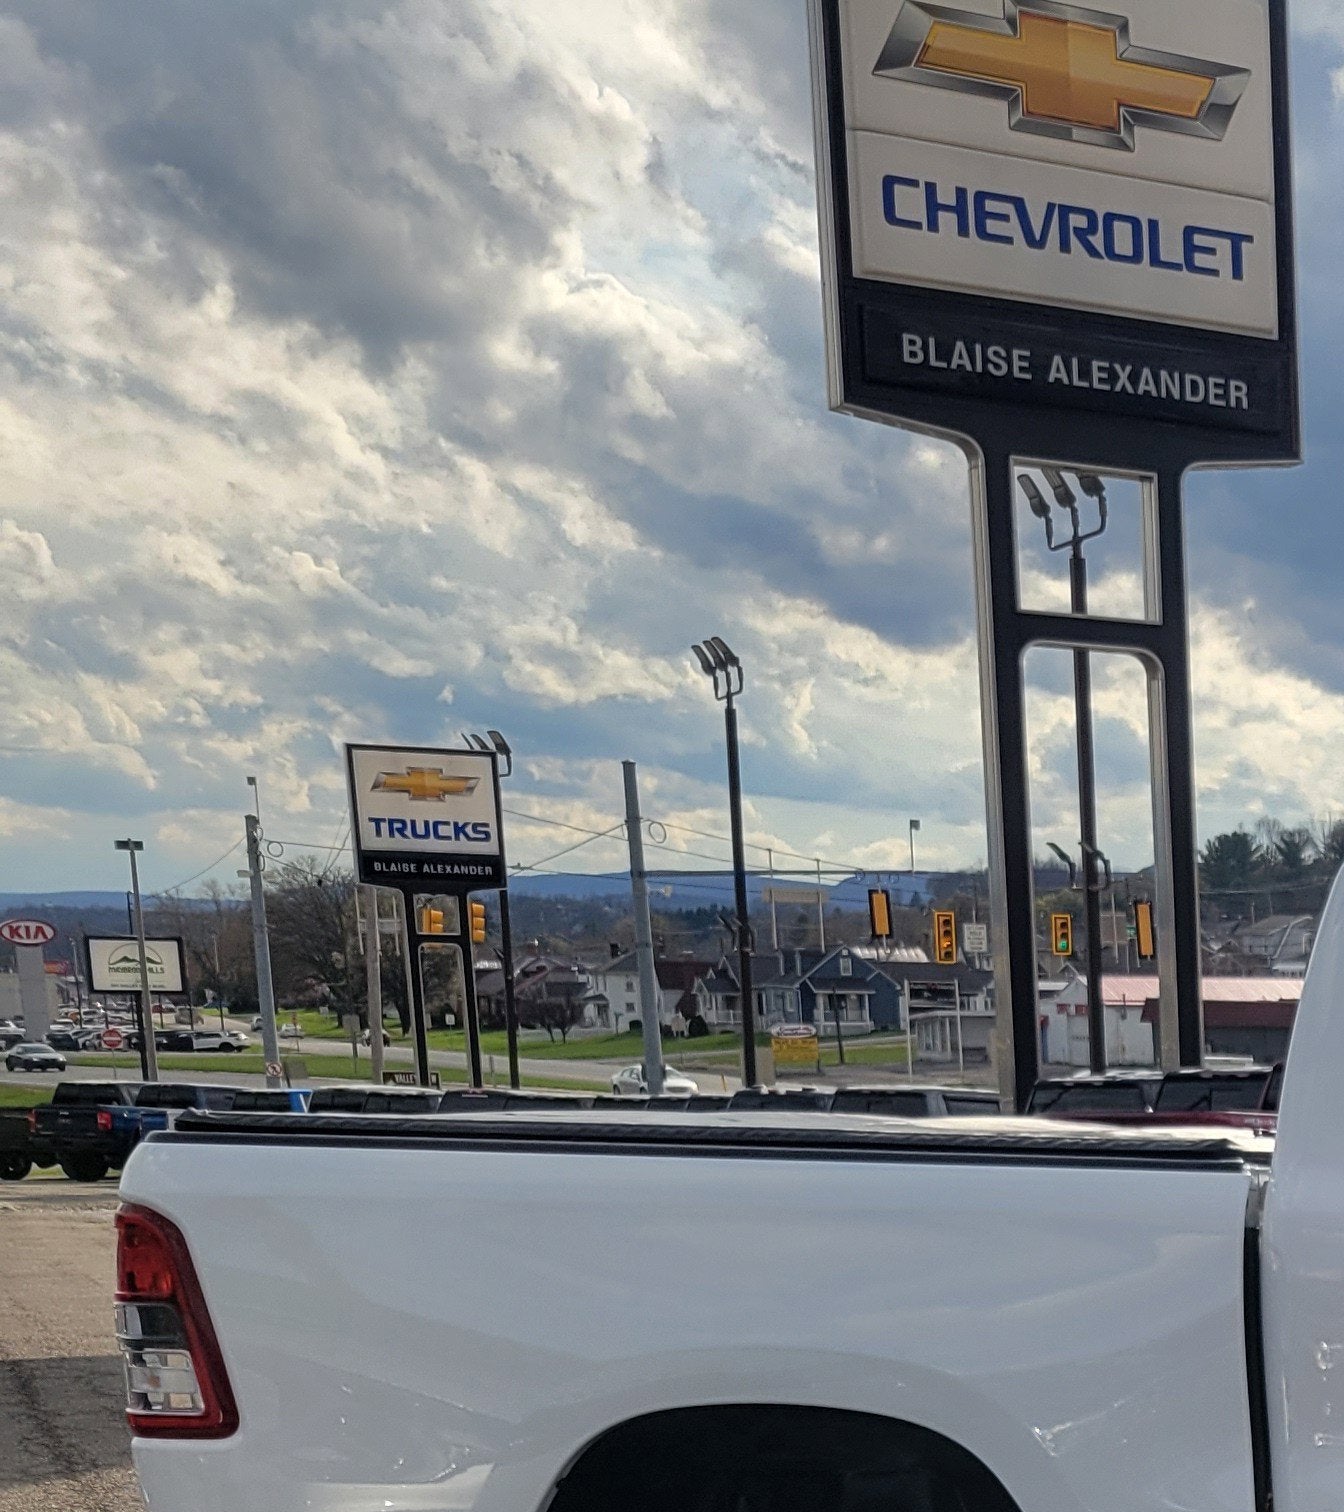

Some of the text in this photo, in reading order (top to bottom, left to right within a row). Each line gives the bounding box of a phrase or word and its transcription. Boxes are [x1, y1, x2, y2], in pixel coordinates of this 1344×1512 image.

[881, 174, 1254, 281] CHEVROLET
[901, 332, 1249, 411] BLAISE ALEXANDER
[368, 817, 492, 843] TRUCKS
[373, 861, 493, 876] BLAISE ALEXANDER
[8, 924, 49, 940] KIA
